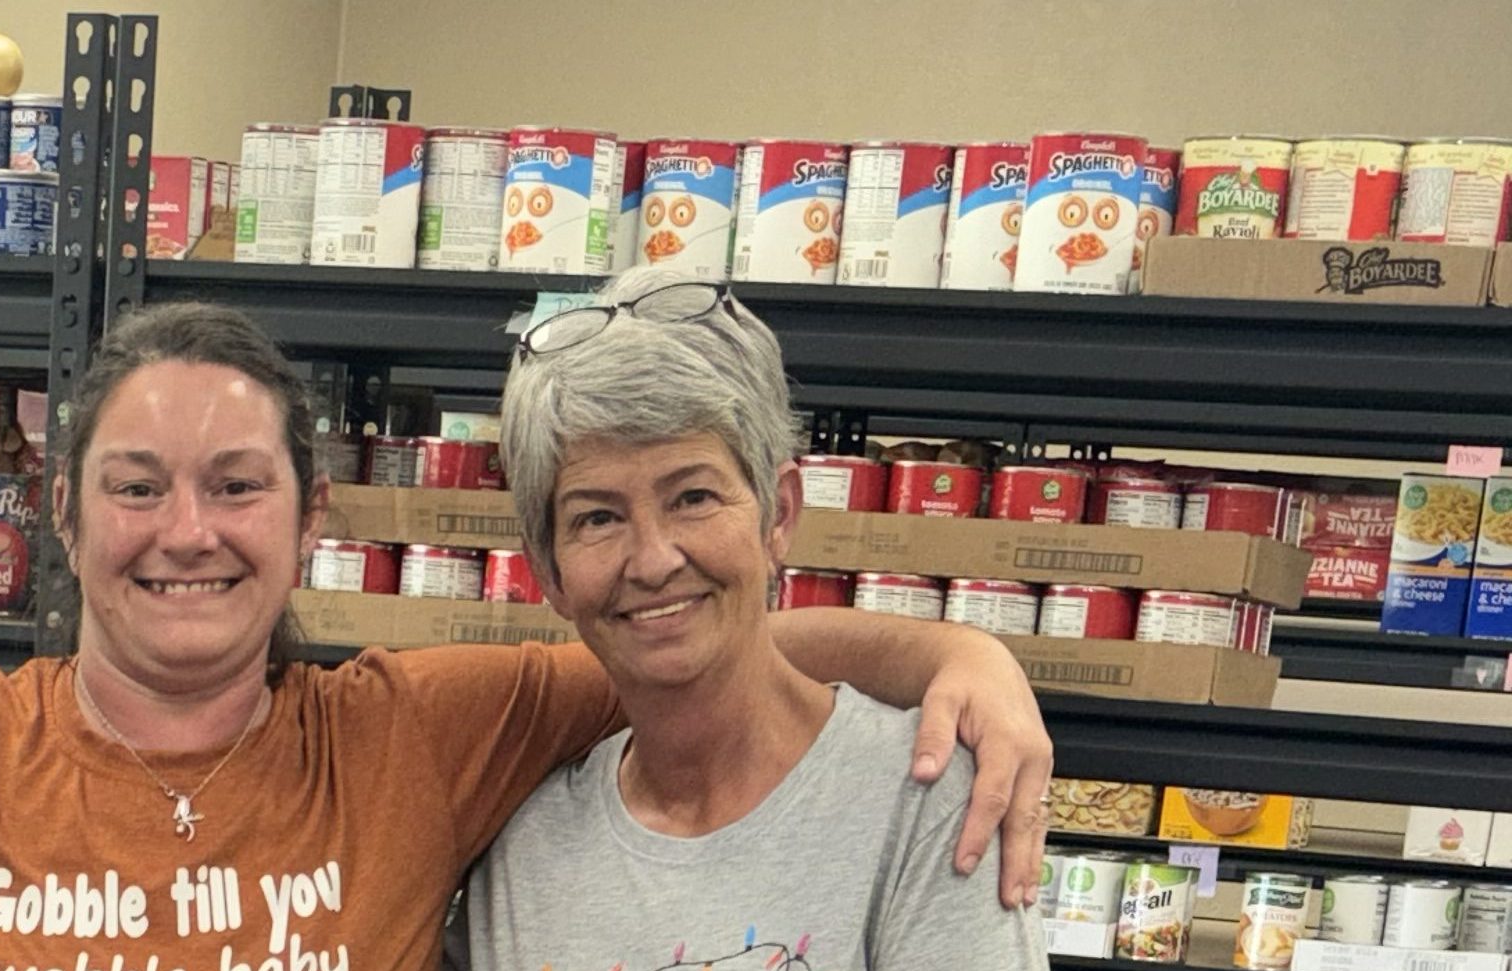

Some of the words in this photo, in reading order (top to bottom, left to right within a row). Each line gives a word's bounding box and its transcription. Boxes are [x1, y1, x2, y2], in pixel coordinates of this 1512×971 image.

[1208, 174, 1236, 191] Chef
[1199, 189, 1280, 216] BOYARDEE
[1213, 224, 1260, 239] Ravioli
[1349, 261, 1437, 289] BOYARDEE
[1350, 507, 1382, 522] TEA
[1321, 572, 1355, 587] TEA
[1393, 577, 1447, 589] macaroni
[1480, 582, 1512, 593] maca
[1403, 589, 1445, 602] cheese
[1491, 592, 1512, 605] che
[170, 865, 242, 937] till
[259, 861, 342, 954] you
